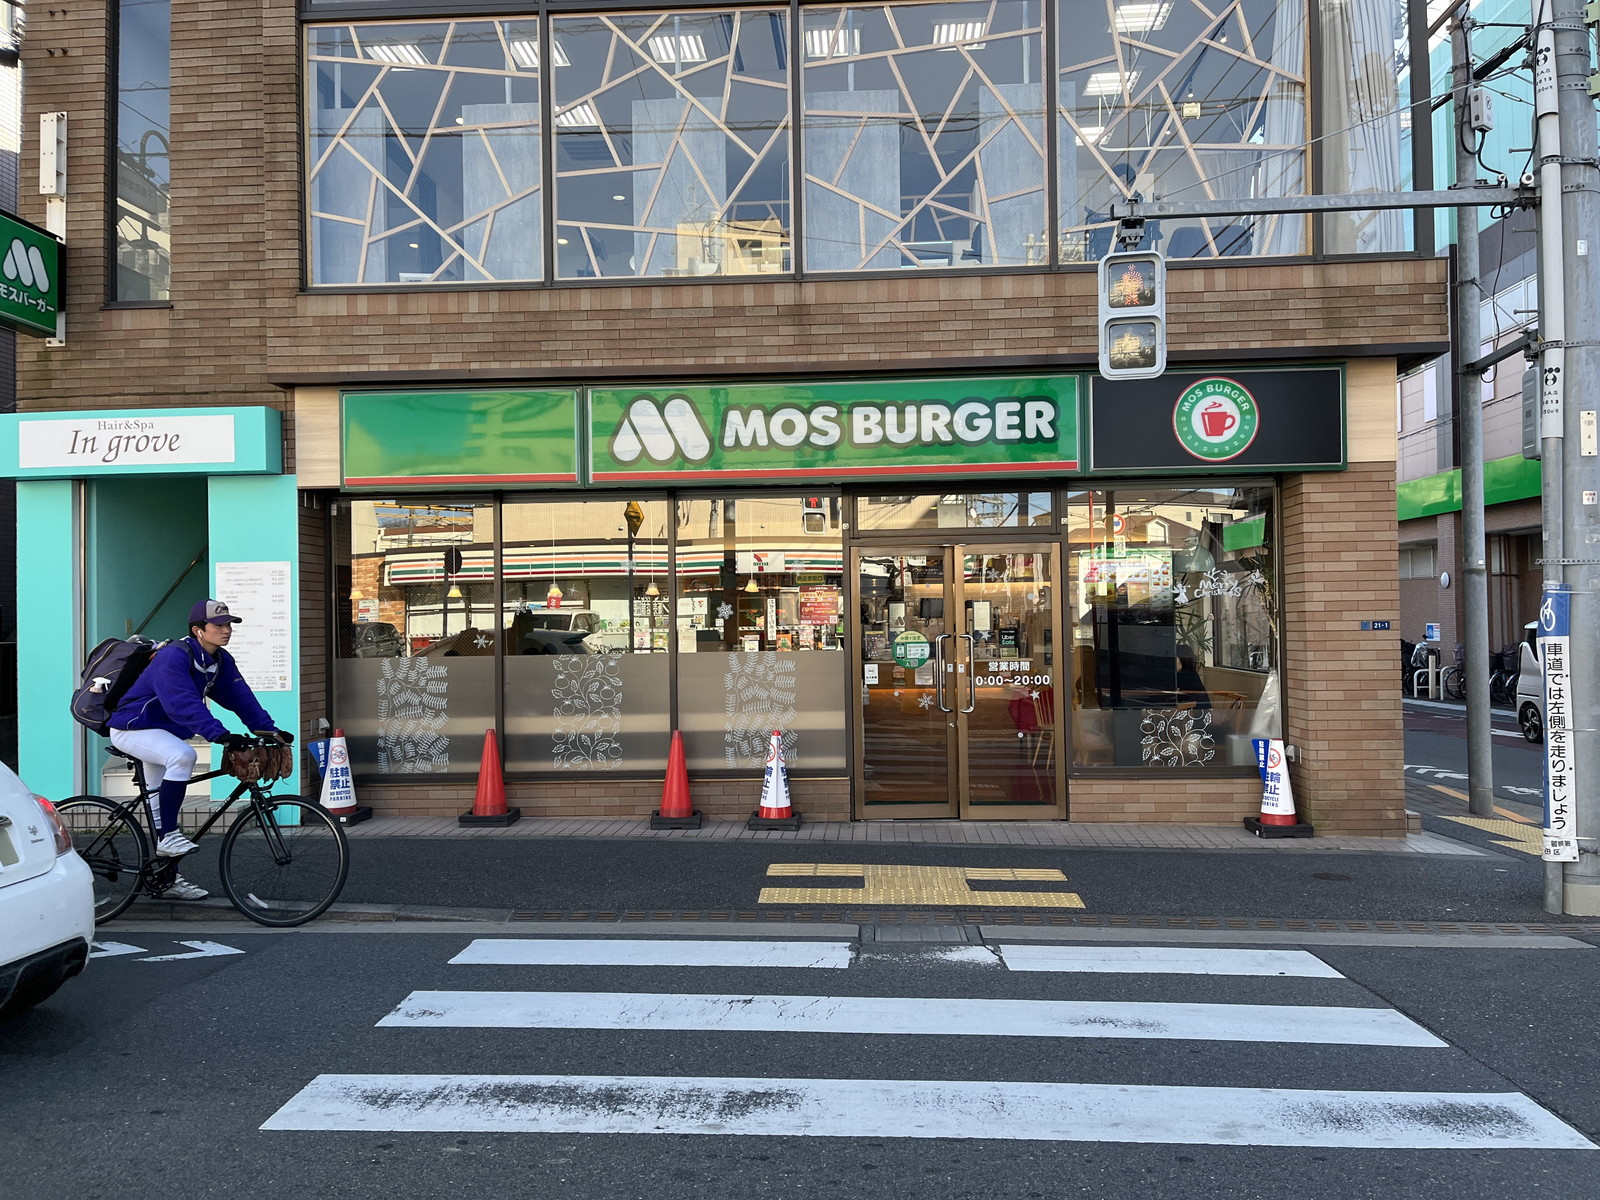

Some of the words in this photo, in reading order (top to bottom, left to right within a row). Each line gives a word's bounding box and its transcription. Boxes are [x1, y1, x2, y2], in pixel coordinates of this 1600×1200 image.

[1181, 388, 1203, 412] MOS
[1206, 383, 1250, 411] BURGER
[97, 420, 155, 432] Hair&Spa
[722, 405, 841, 447] MOS
[852, 400, 1056, 444] BURGER
[67, 429, 99, 455] In
[101, 433, 181, 463] grove
[988, 661, 1031, 672] 営業時間
[975, 674, 1051, 686] 0:00～20:00
[1547, 643, 1567, 830] 車道では左側を走りましょう
[330, 767, 350, 778] 駐輪
[330, 778, 350, 790] 禁止
